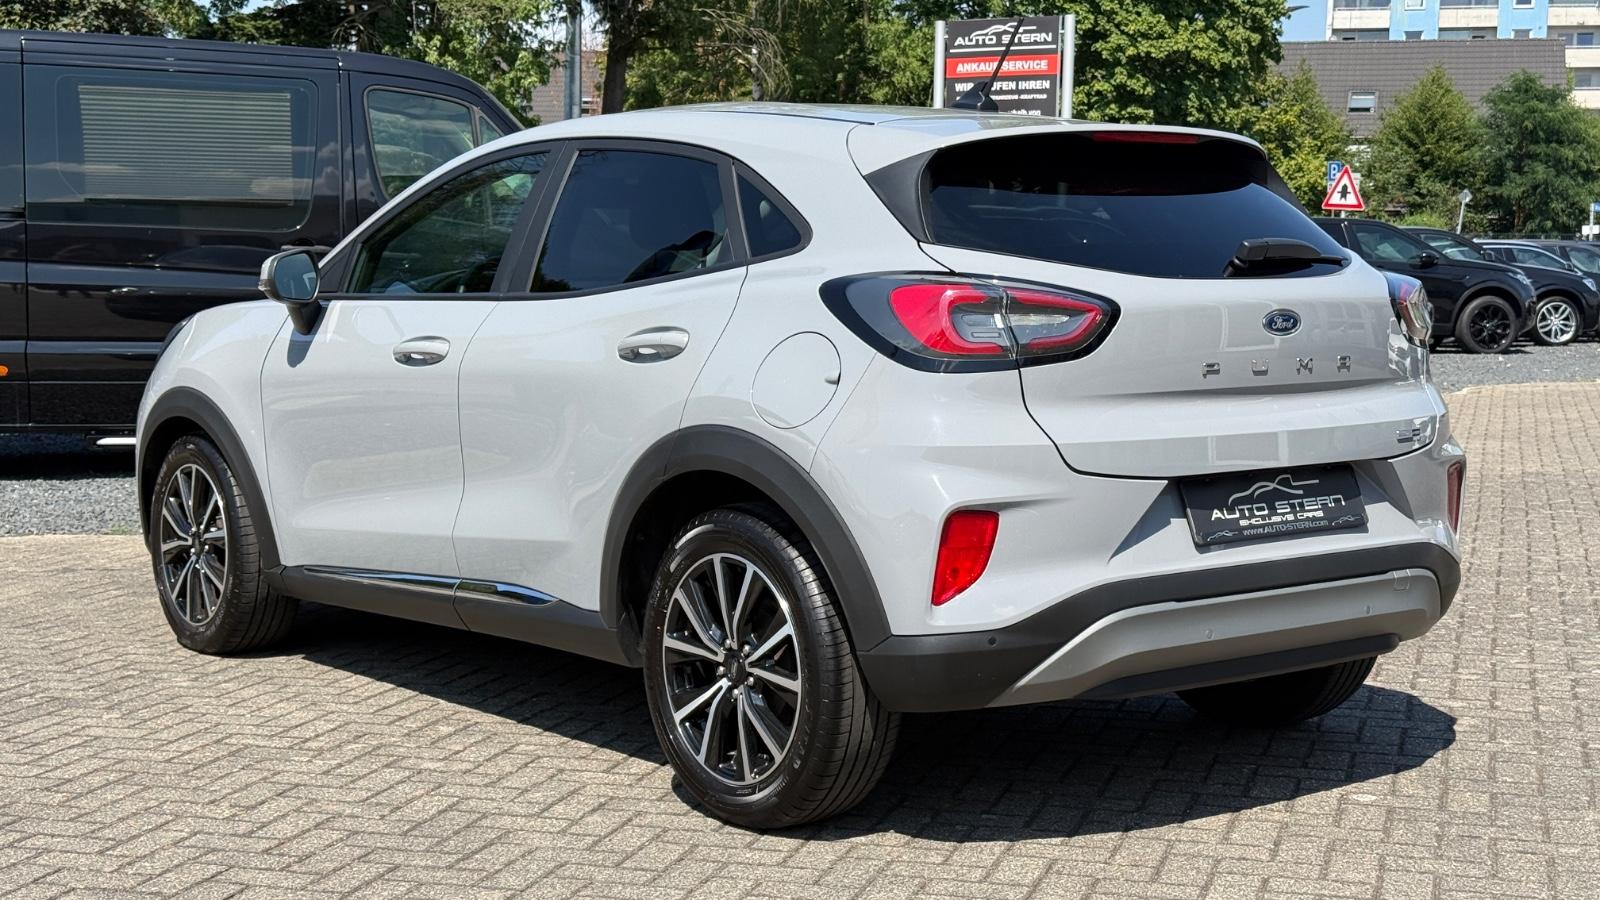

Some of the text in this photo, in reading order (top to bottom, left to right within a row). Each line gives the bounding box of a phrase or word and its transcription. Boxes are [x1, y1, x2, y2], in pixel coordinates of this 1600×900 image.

[954, 35, 996, 46] AUTO
[1018, 80, 1050, 90] IHREN
[1271, 315, 1294, 329] Ford
[1202, 355, 1351, 379] PUMA
[1211, 494, 1346, 521] AUTO STERN
[1239, 510, 1324, 526] EXCLUSIVE CARS
